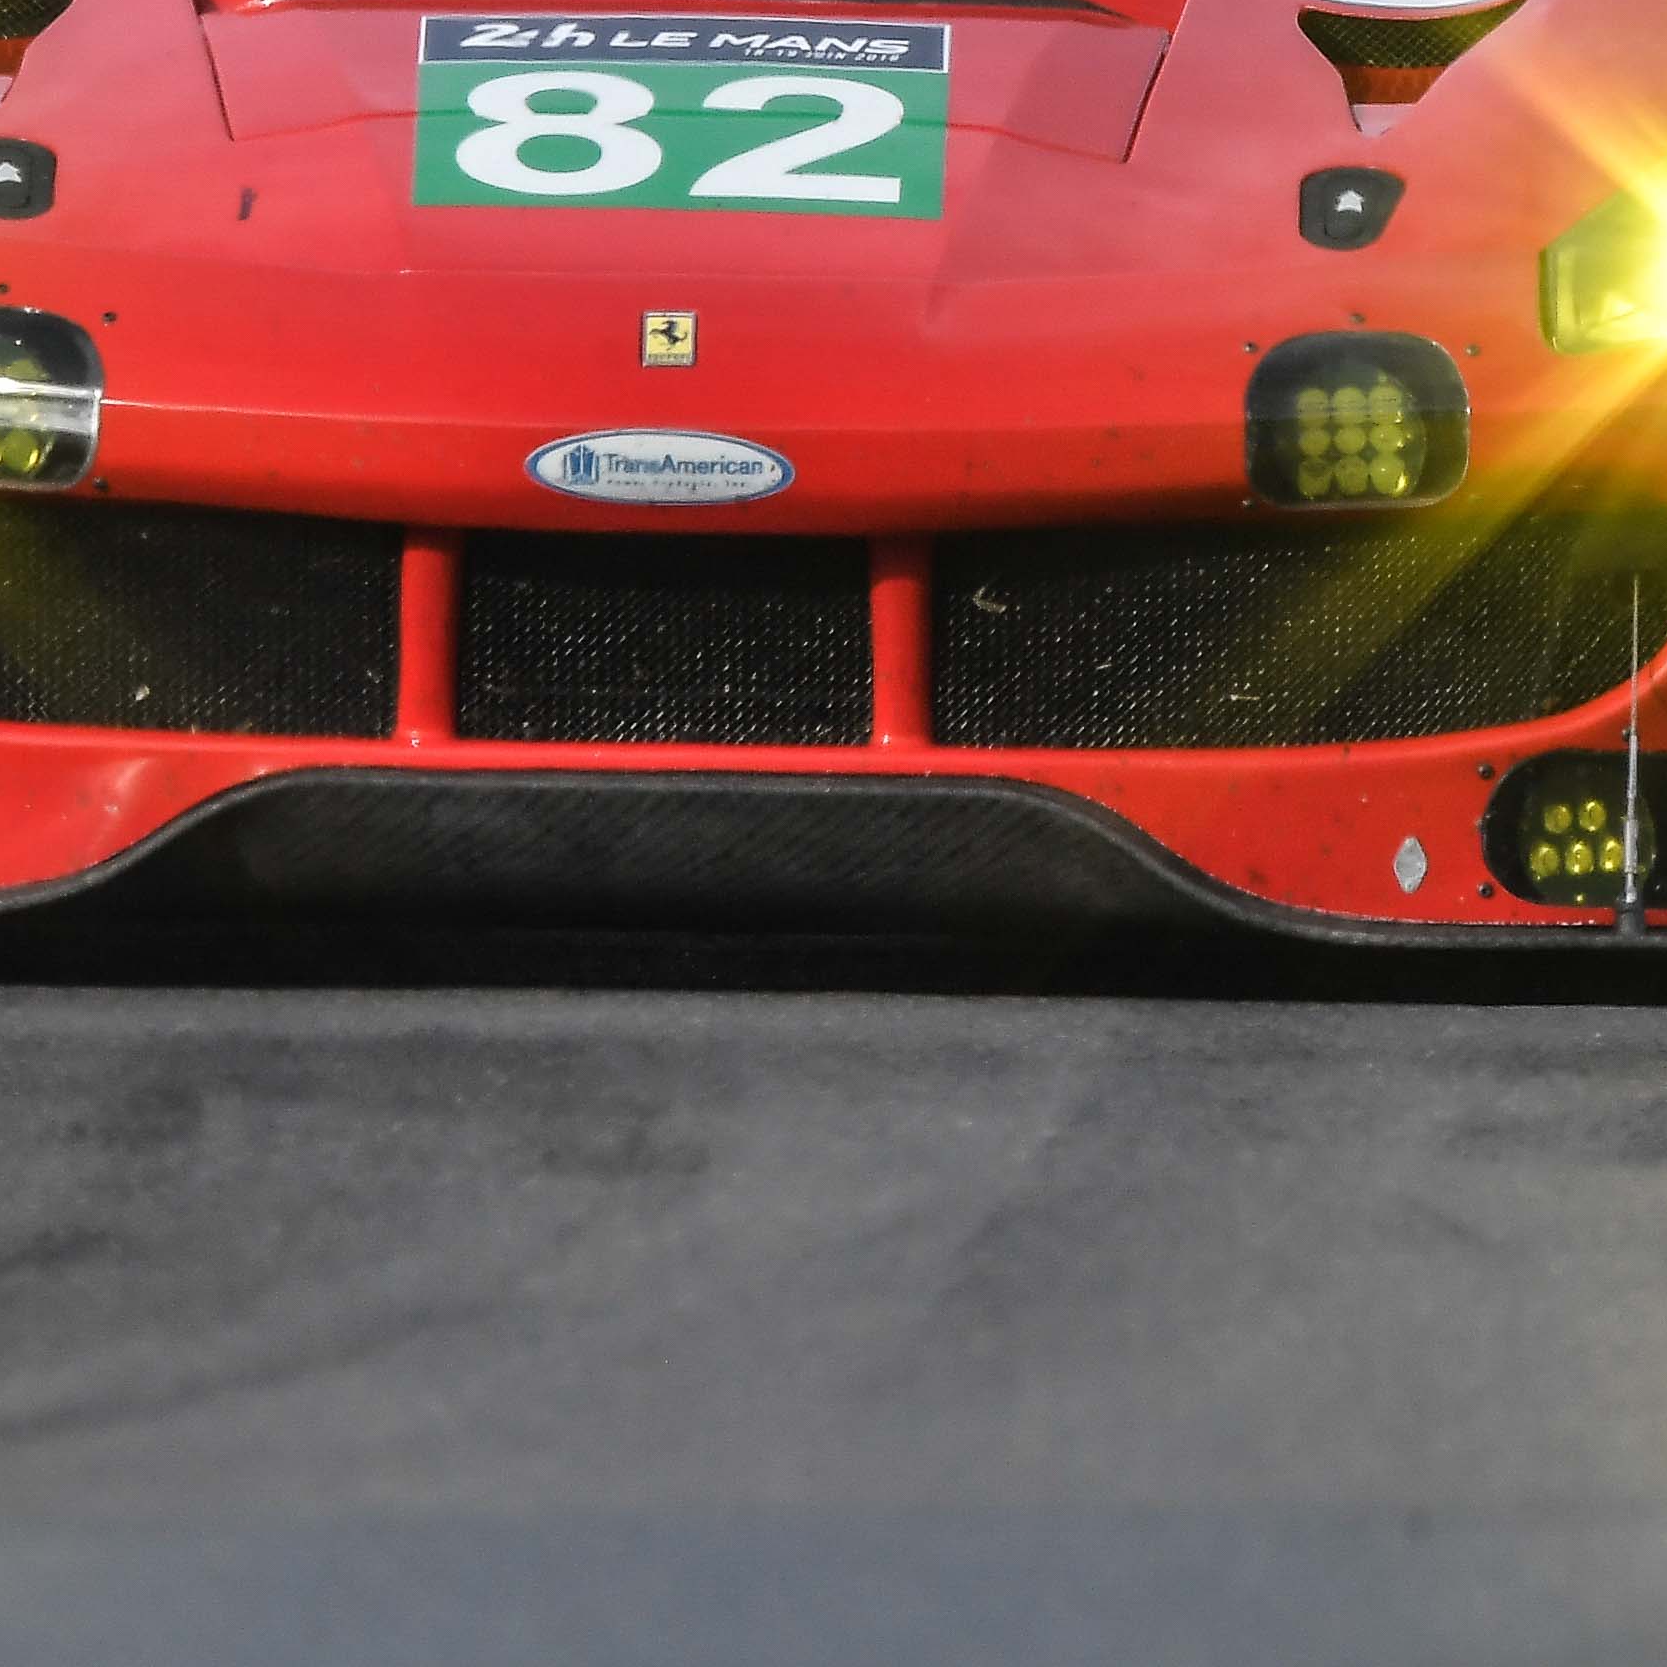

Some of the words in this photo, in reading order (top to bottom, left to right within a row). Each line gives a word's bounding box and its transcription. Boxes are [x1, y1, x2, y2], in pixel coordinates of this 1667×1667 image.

[609, 31, 697, 49] LE
[710, 32, 910, 55] MANS
[456, 71, 904, 203] 82
[603, 453, 763, 475] TransAmerican
